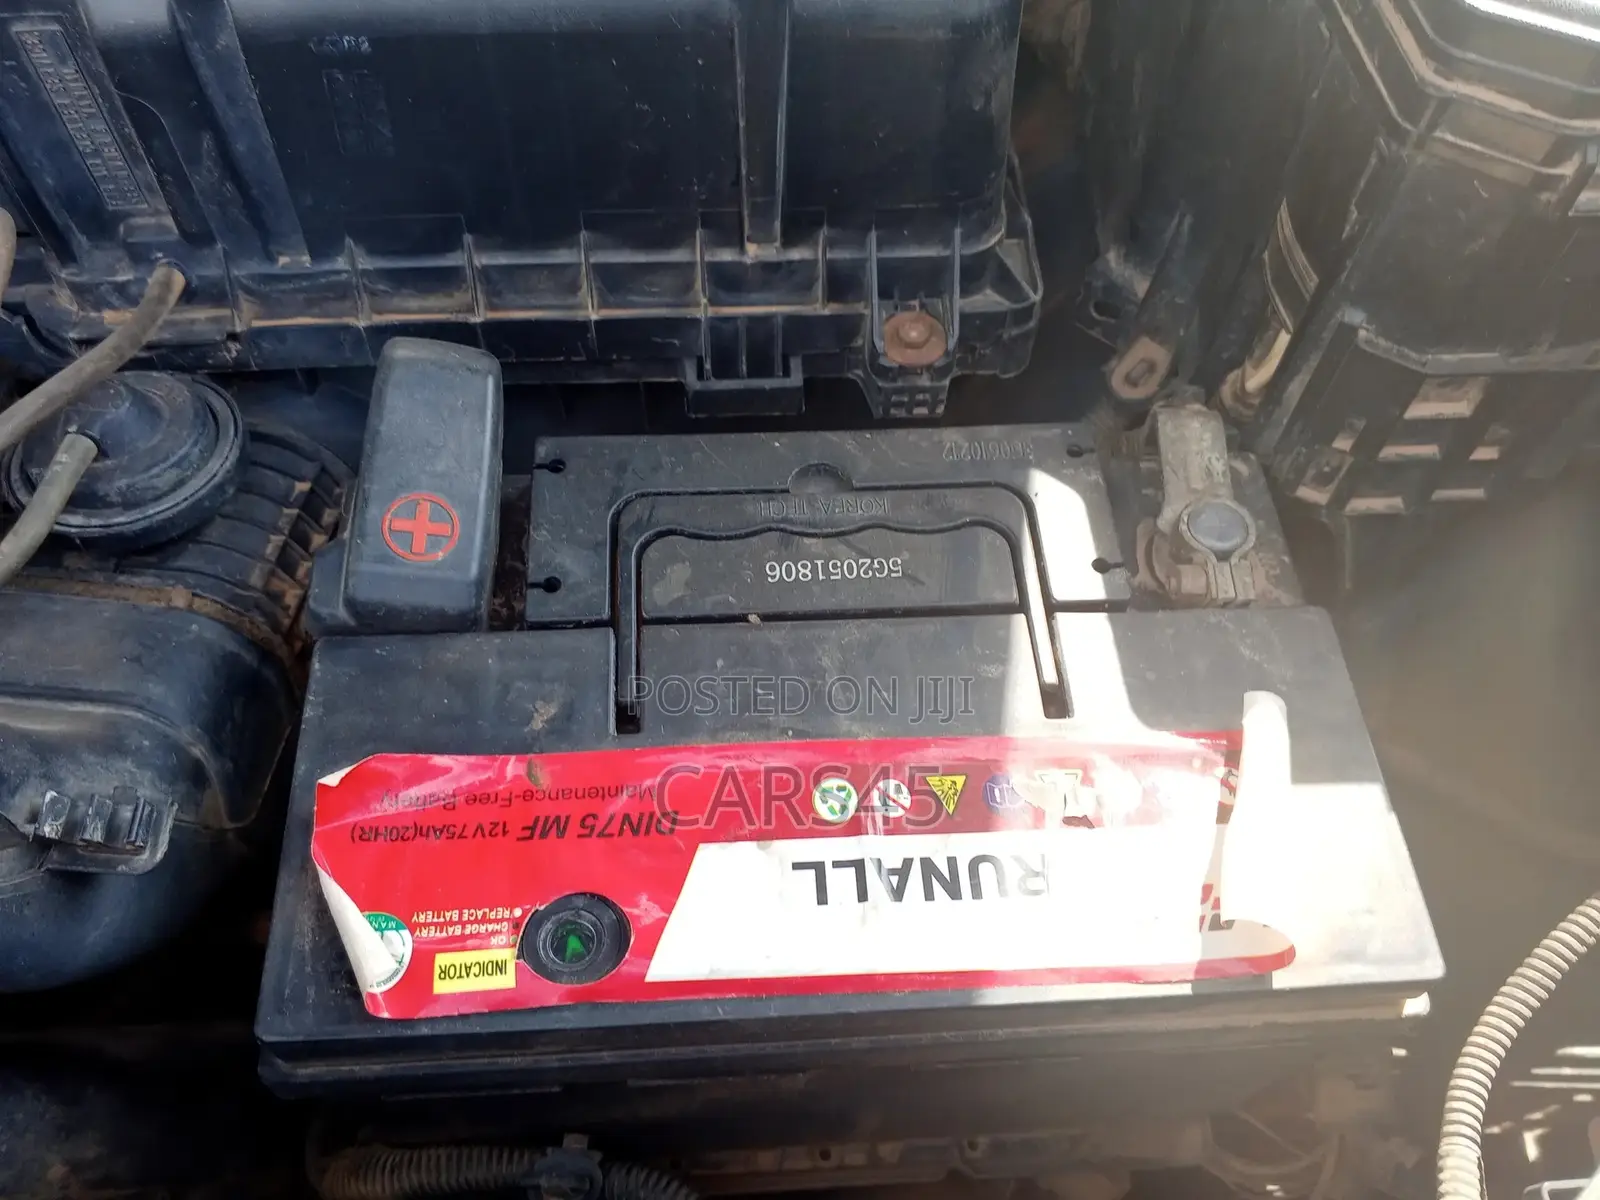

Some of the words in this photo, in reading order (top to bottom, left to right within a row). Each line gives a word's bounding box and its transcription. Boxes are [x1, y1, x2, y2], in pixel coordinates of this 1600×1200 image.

[758, 499, 809, 517] TECH
[819, 497, 892, 515] KOREA
[765, 557, 903, 583] 5G2051806
[379, 788, 457, 812] Battery
[465, 783, 658, 809] Maintenance-Free
[351, 819, 470, 843] 75Ah(20HR)
[474, 820, 510, 839] 12V
[516, 813, 572, 841] MF
[577, 810, 681, 839] DIN75
[791, 854, 1049, 906] RUNALL
[411, 908, 459, 923] BATTERY
[461, 907, 511, 920] REPLACE
[413, 923, 463, 937] BATTERY
[465, 921, 509, 934] CHARGE
[490, 935, 507, 946] OK
[438, 957, 508, 979] INDICATOR
